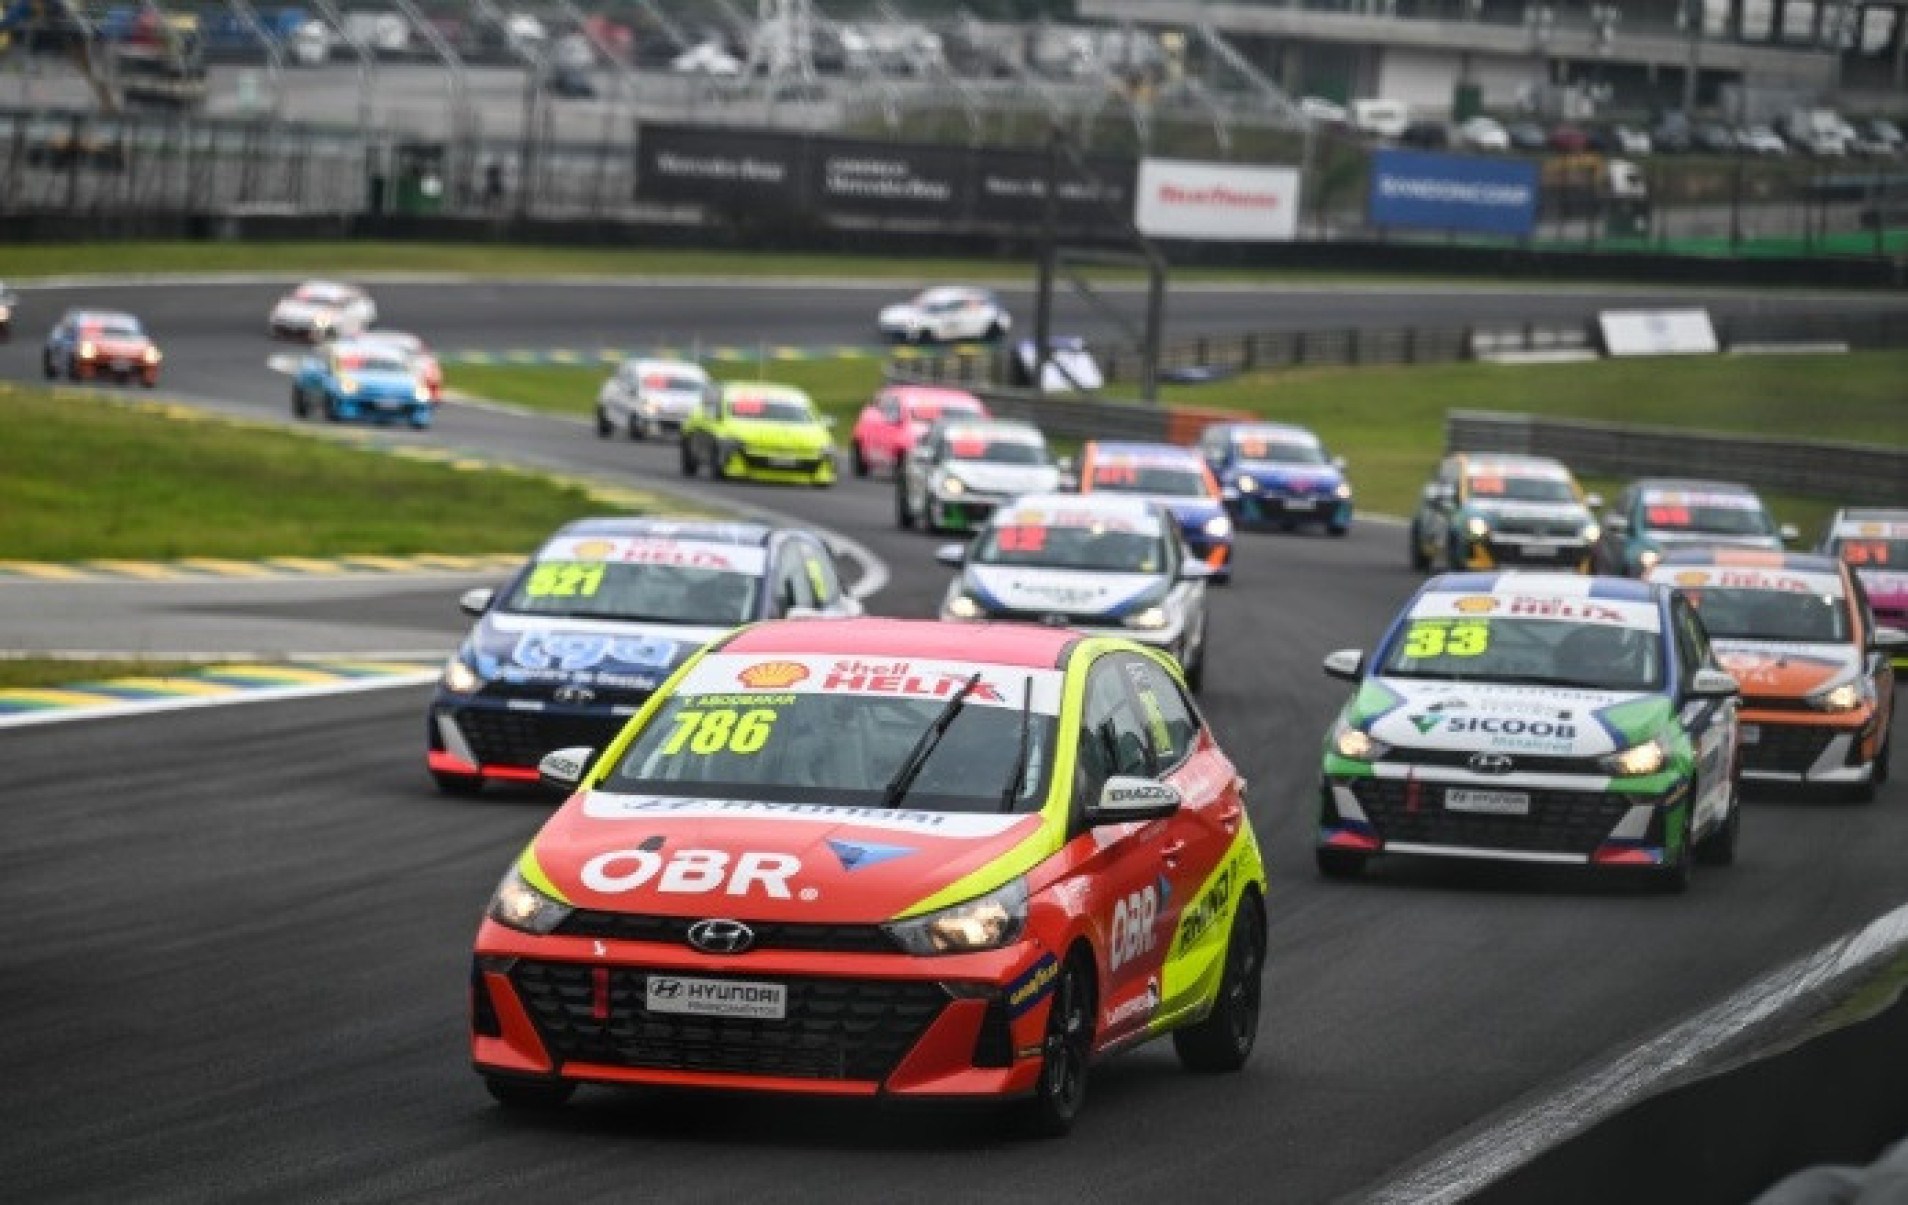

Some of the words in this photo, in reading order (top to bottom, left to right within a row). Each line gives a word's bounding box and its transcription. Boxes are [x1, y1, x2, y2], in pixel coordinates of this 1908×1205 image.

[1403, 622, 1489, 659] 33
[832, 659, 910, 676] Shell
[822, 673, 1006, 703] HELIX
[663, 708, 778, 755] 786
[1448, 717, 1578, 739] SICOOB
[1111, 884, 1159, 972] OBR
[687, 984, 781, 1005] HYUNDAI
